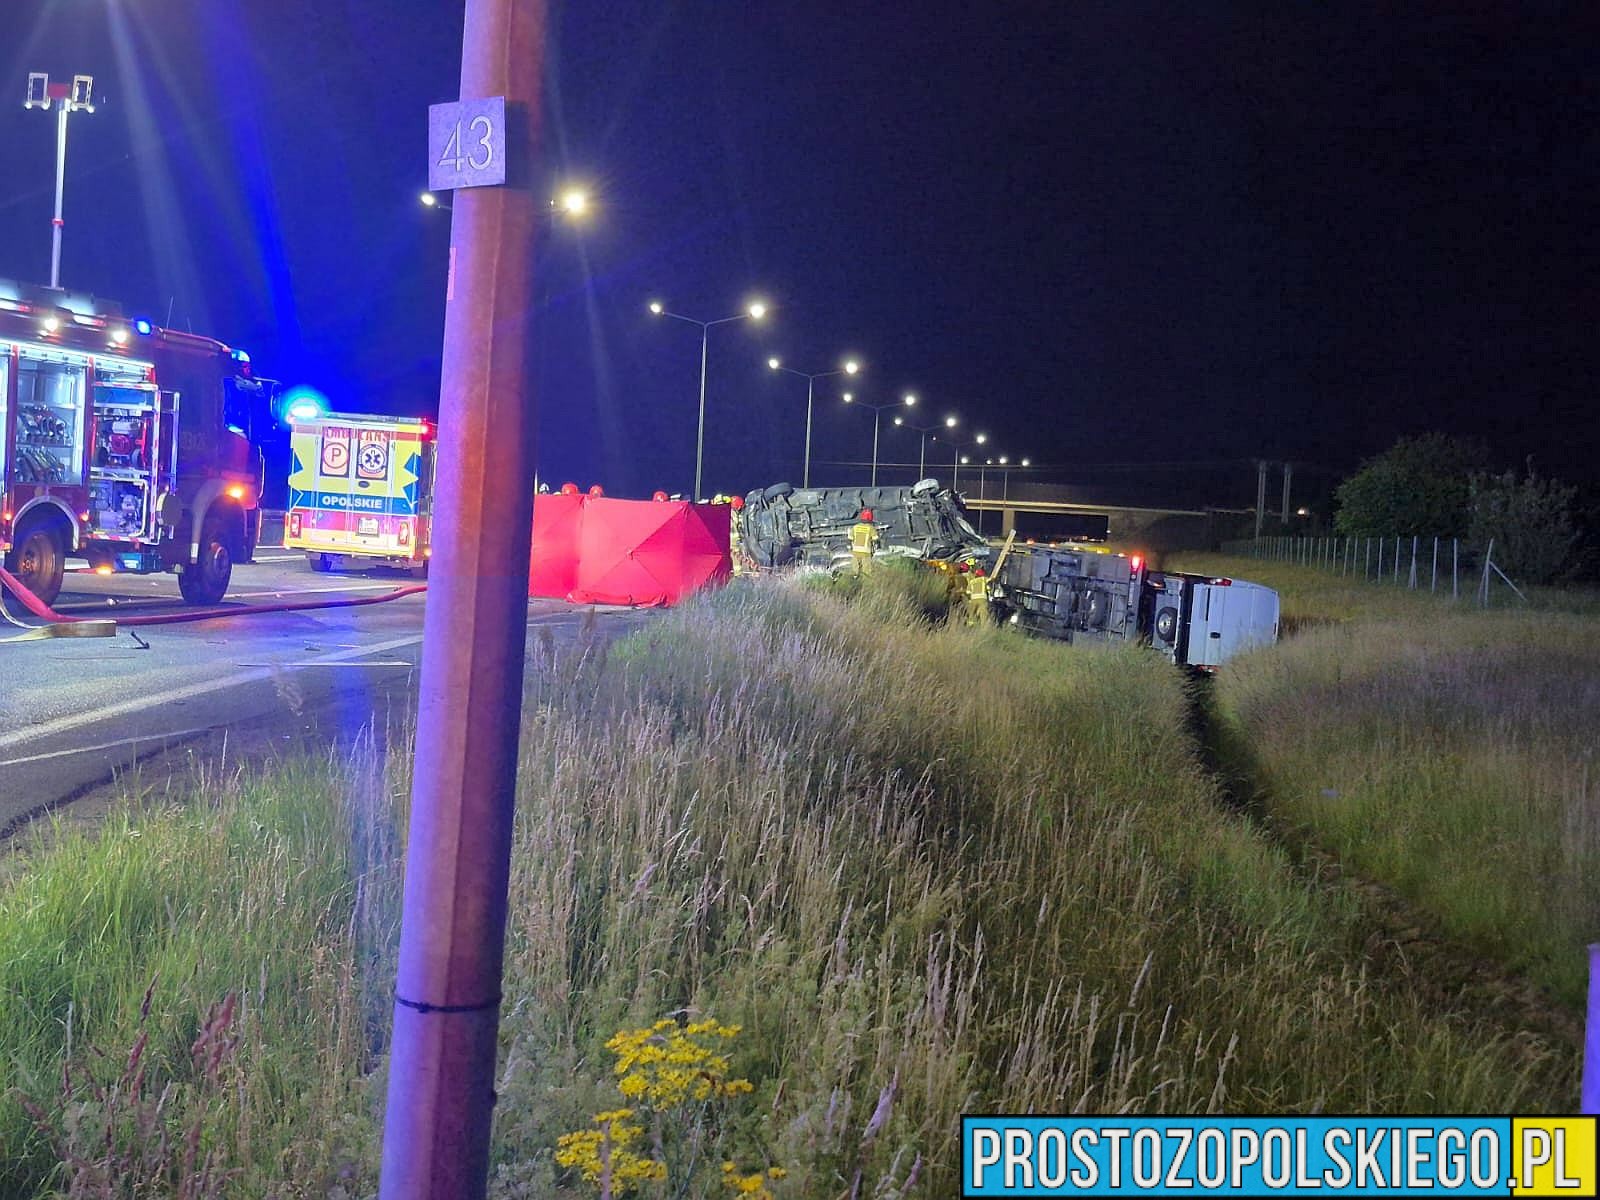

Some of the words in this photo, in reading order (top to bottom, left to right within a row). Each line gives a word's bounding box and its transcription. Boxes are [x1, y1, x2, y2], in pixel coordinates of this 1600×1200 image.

[438, 116, 493, 172] 43
[331, 448, 342, 462] P
[322, 495, 383, 508] OPOLSKIE
